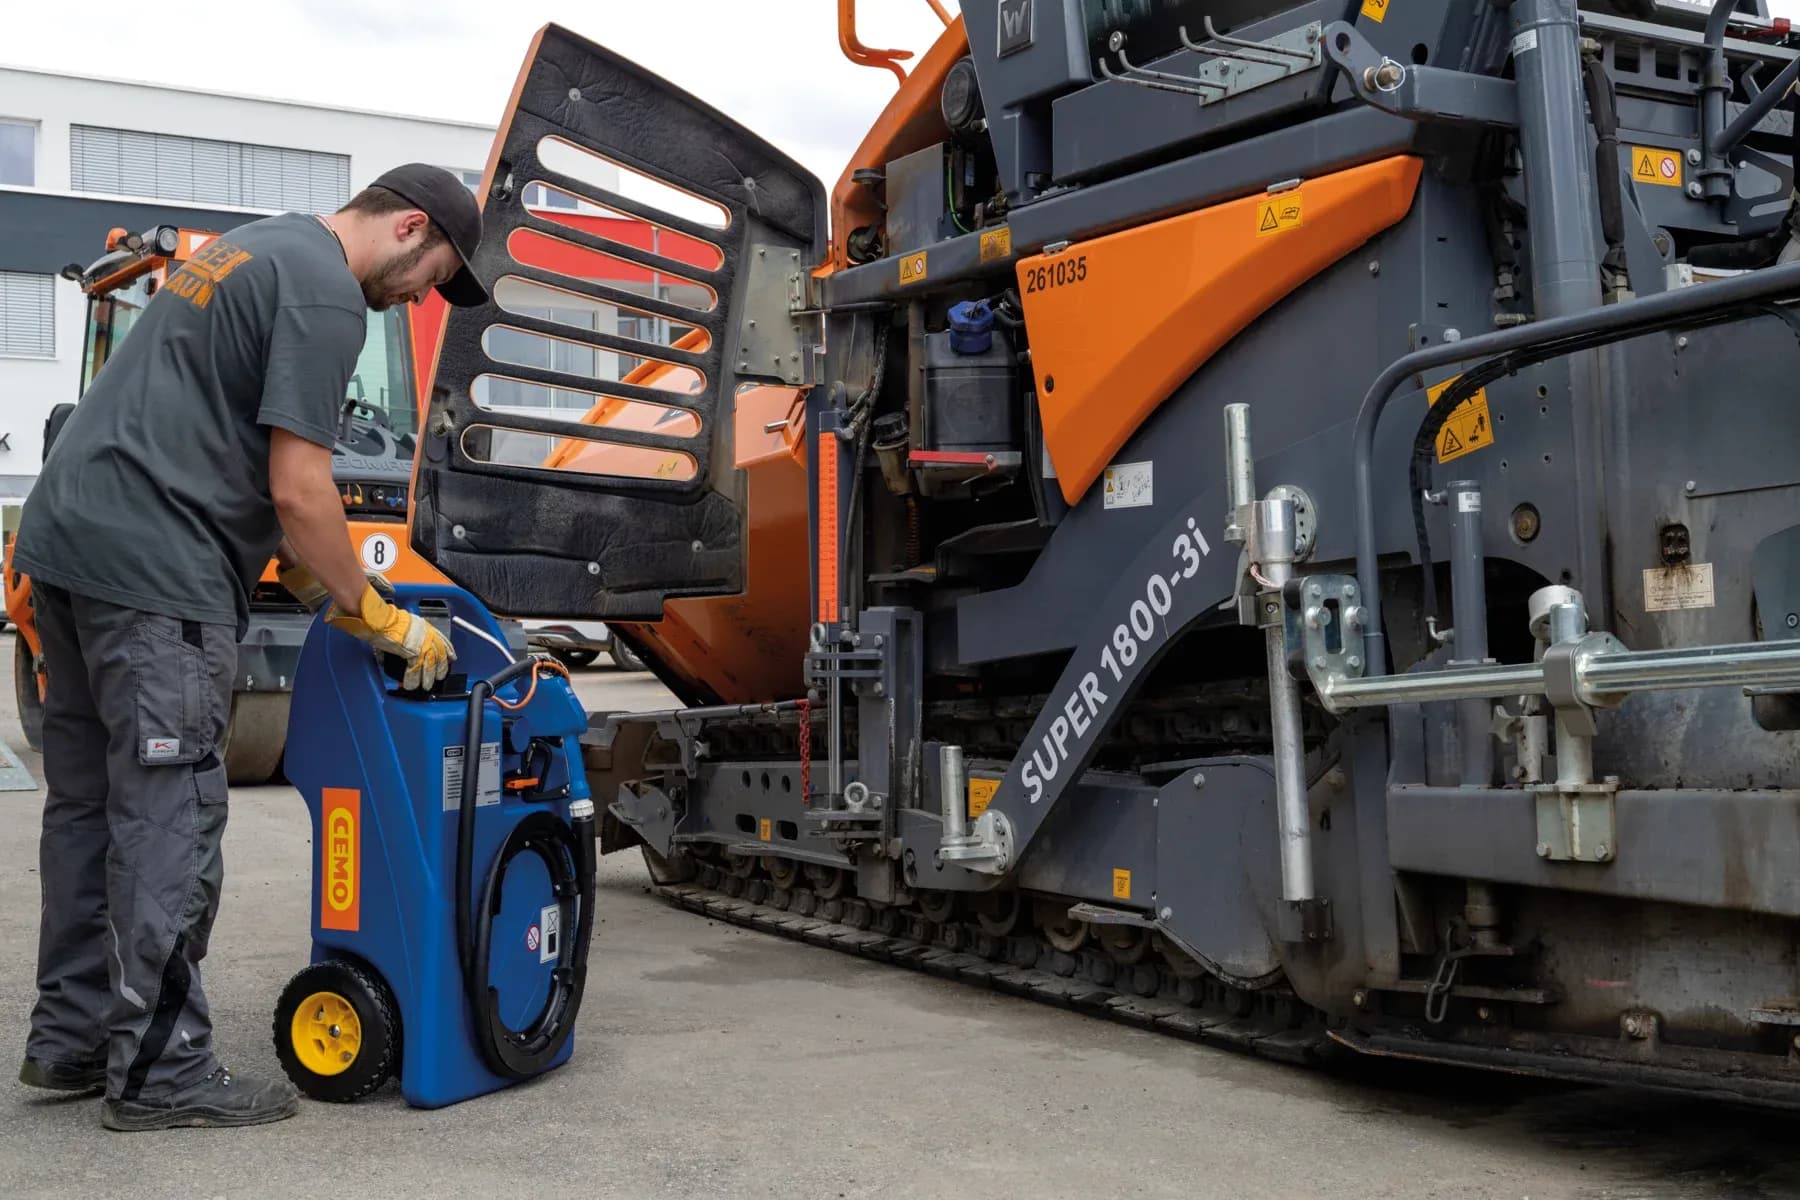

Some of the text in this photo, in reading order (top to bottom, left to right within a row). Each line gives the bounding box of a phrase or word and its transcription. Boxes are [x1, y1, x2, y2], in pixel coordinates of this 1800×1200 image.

[1027, 255, 1087, 294] 261035
[374, 540, 385, 565] 8
[1021, 517, 1210, 804] SUPER 1800-3i
[333, 816, 348, 904] CEMO
